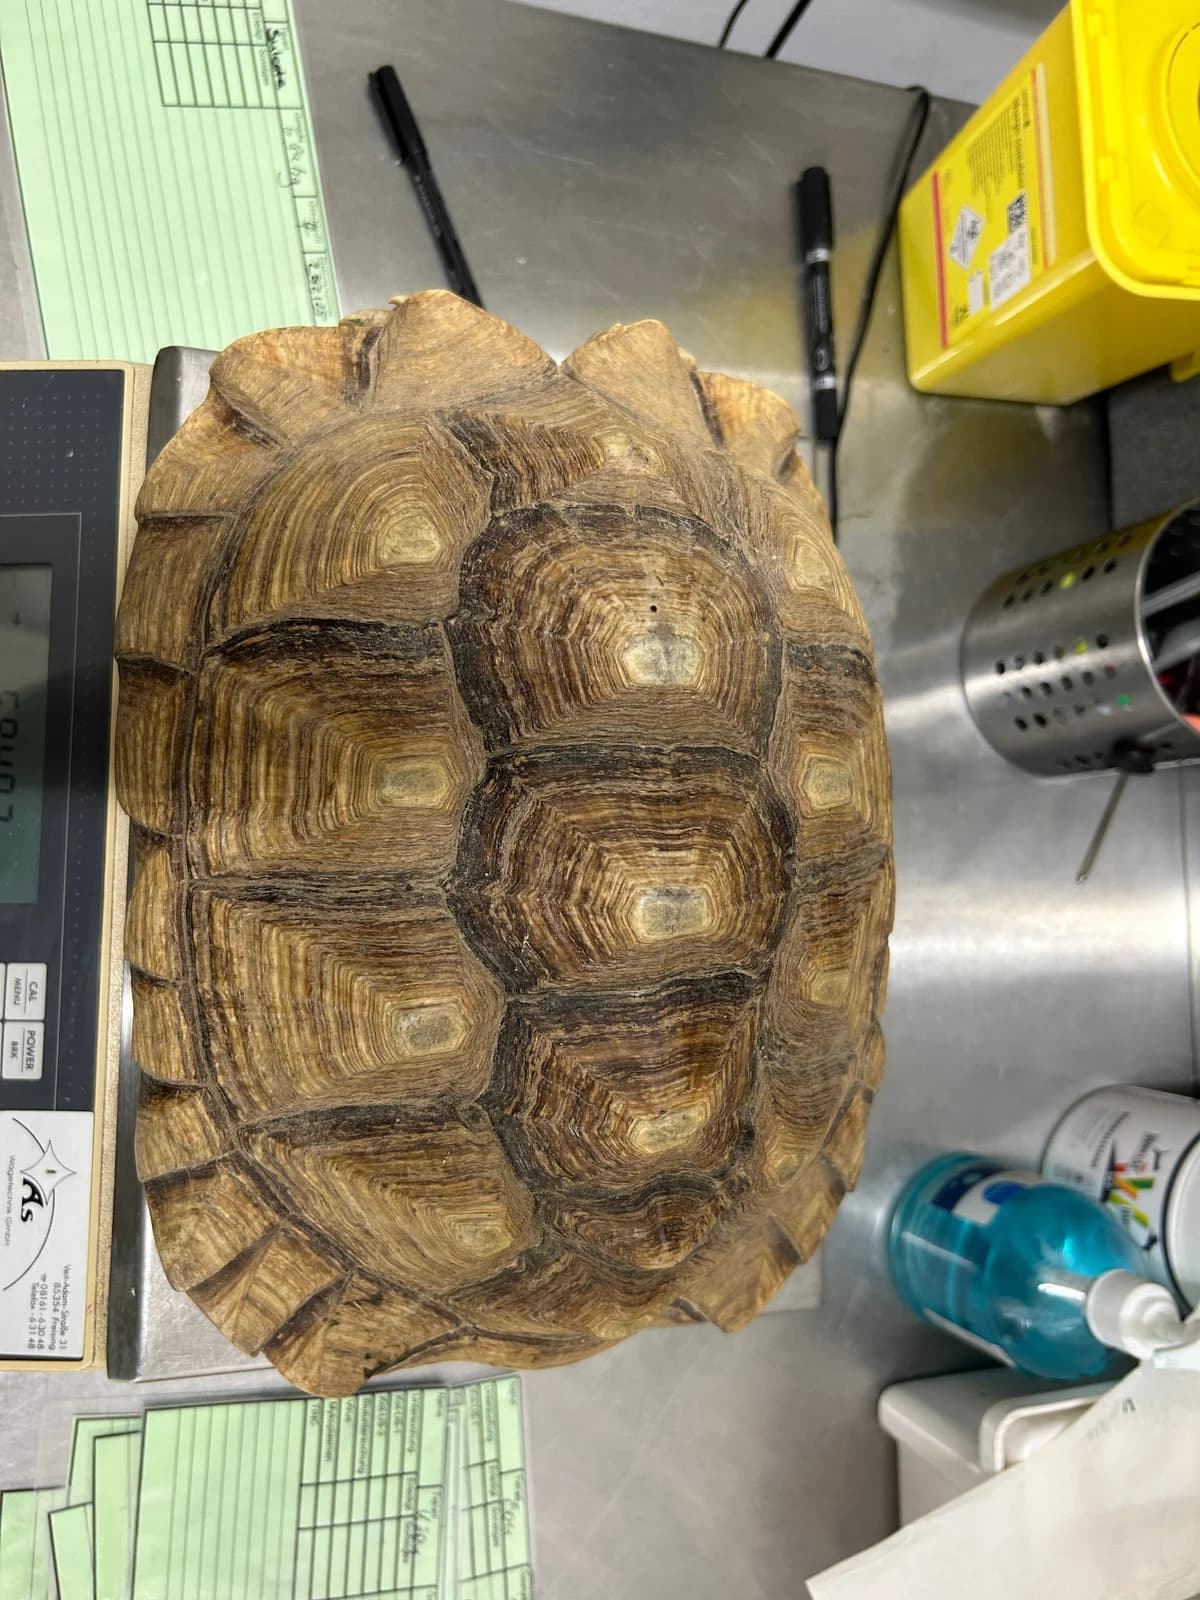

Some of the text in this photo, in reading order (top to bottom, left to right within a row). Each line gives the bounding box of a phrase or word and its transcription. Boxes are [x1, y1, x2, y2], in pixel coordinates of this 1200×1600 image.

[14, 977, 22, 1006] MENU
[29, 981, 38, 1002] CAL
[11, 1041, 19, 1059] BRK
[25, 1030, 36, 1071] POWER
[48, 1282, 61, 1350] 85354 Freising
[60, 1339, 68, 1350] 31
